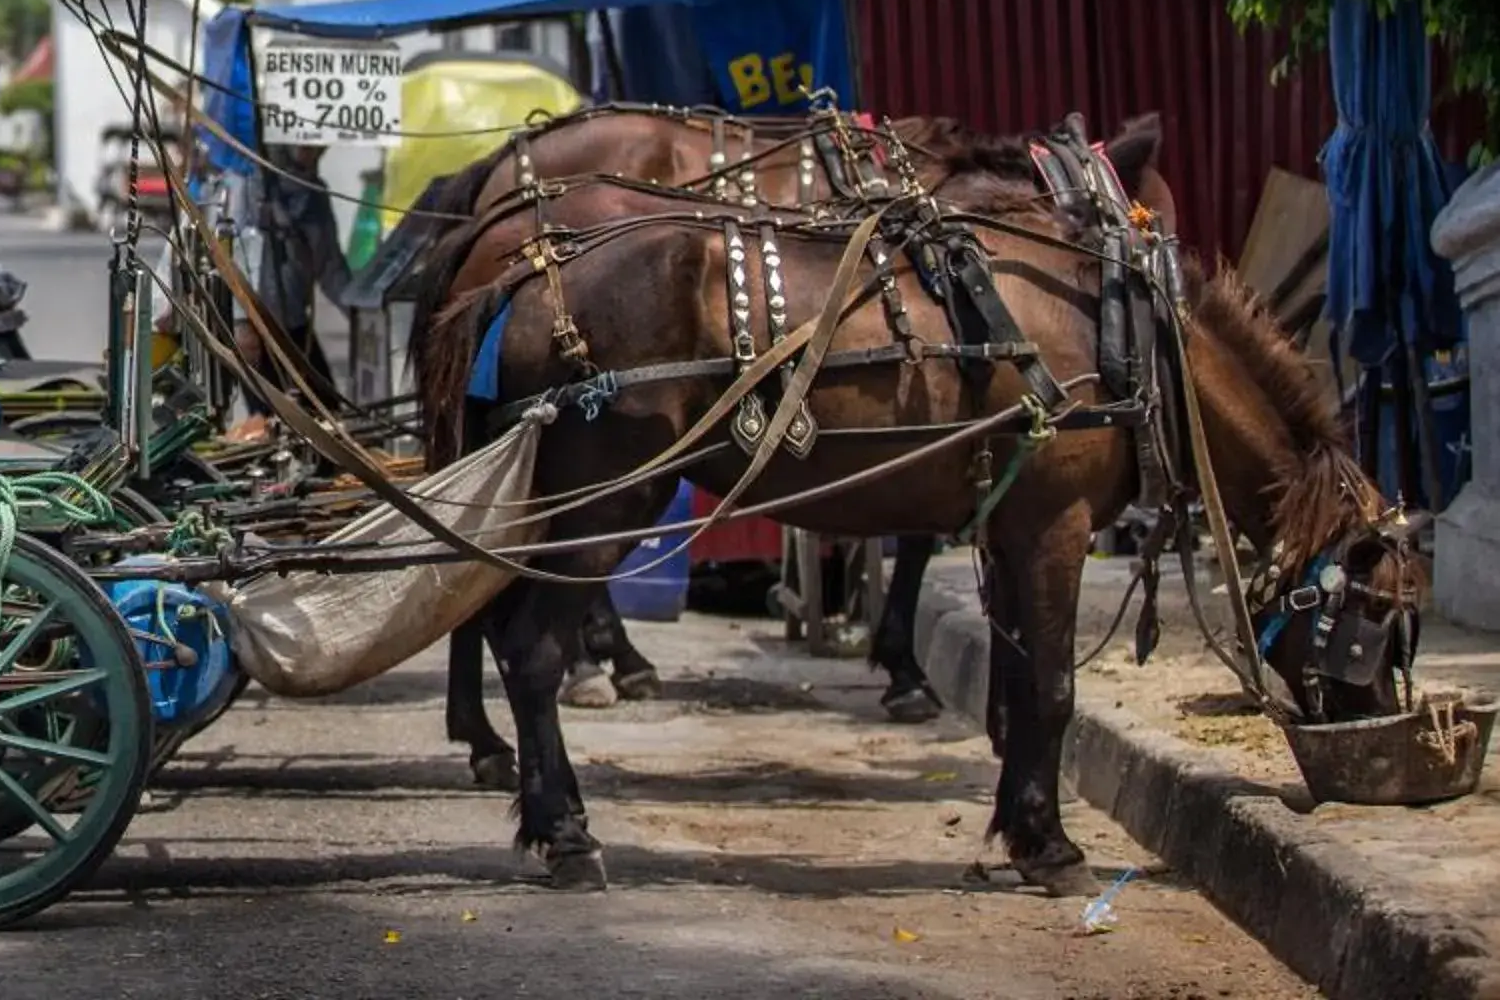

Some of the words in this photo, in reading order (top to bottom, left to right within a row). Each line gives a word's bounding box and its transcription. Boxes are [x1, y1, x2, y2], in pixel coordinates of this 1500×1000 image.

[266, 53, 334, 74] BENSIN
[341, 53, 400, 76] MURNI
[283, 77, 344, 100] 100
[357, 79, 387, 101] %
[266, 104, 305, 133] Rp.
